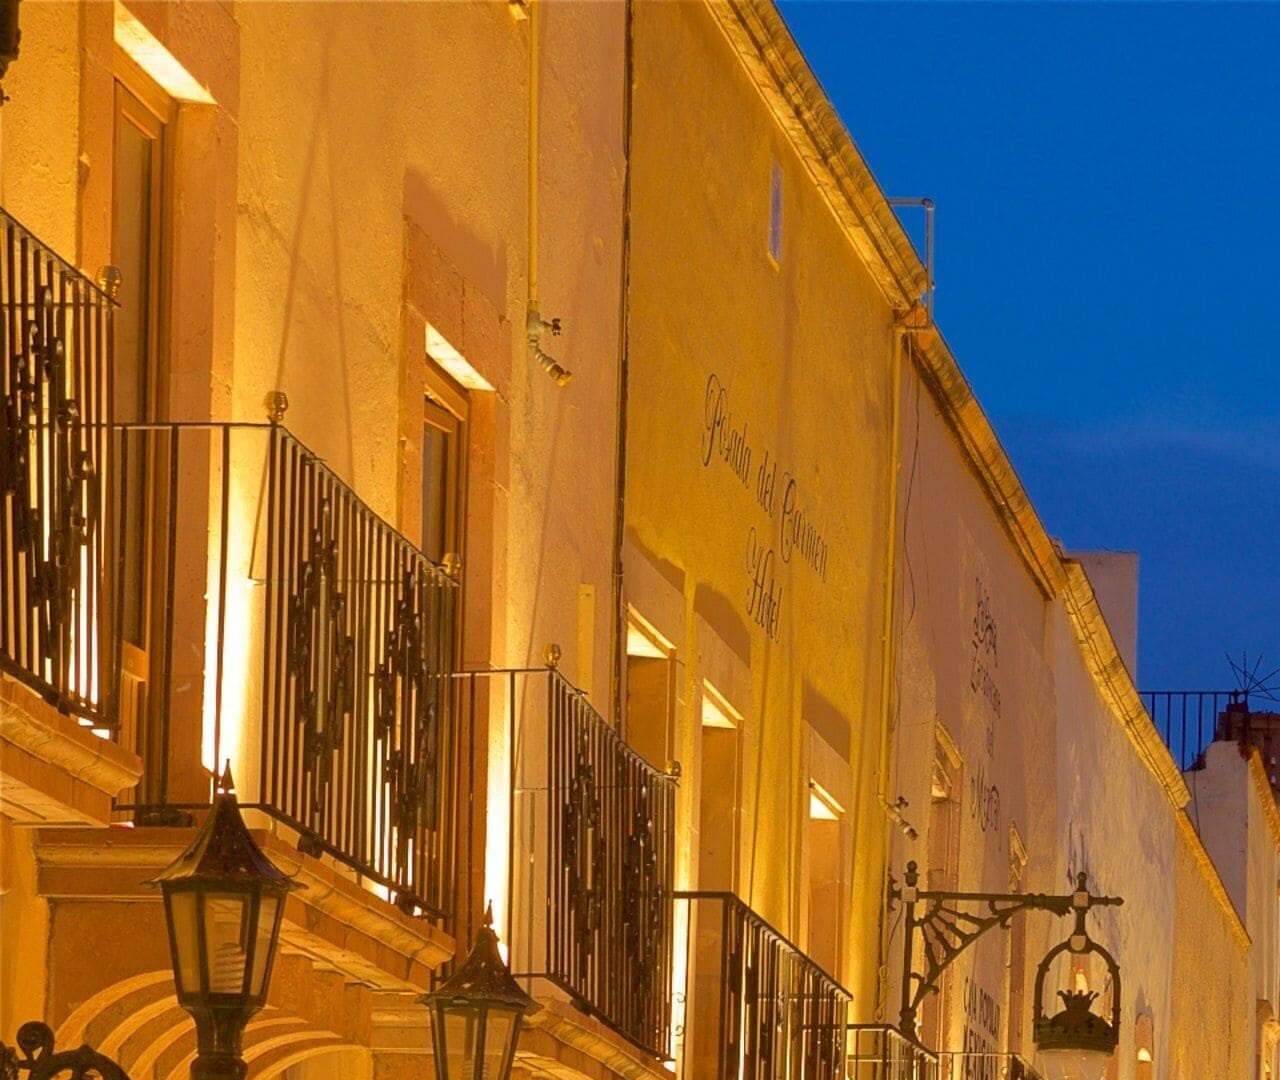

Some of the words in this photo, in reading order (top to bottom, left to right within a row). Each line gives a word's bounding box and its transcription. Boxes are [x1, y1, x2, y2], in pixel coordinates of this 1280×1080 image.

[702, 373, 751, 489] Posada
[756, 450, 777, 518] del
[780, 471, 829, 583] Carmen
[746, 526, 784, 644] Hotel
